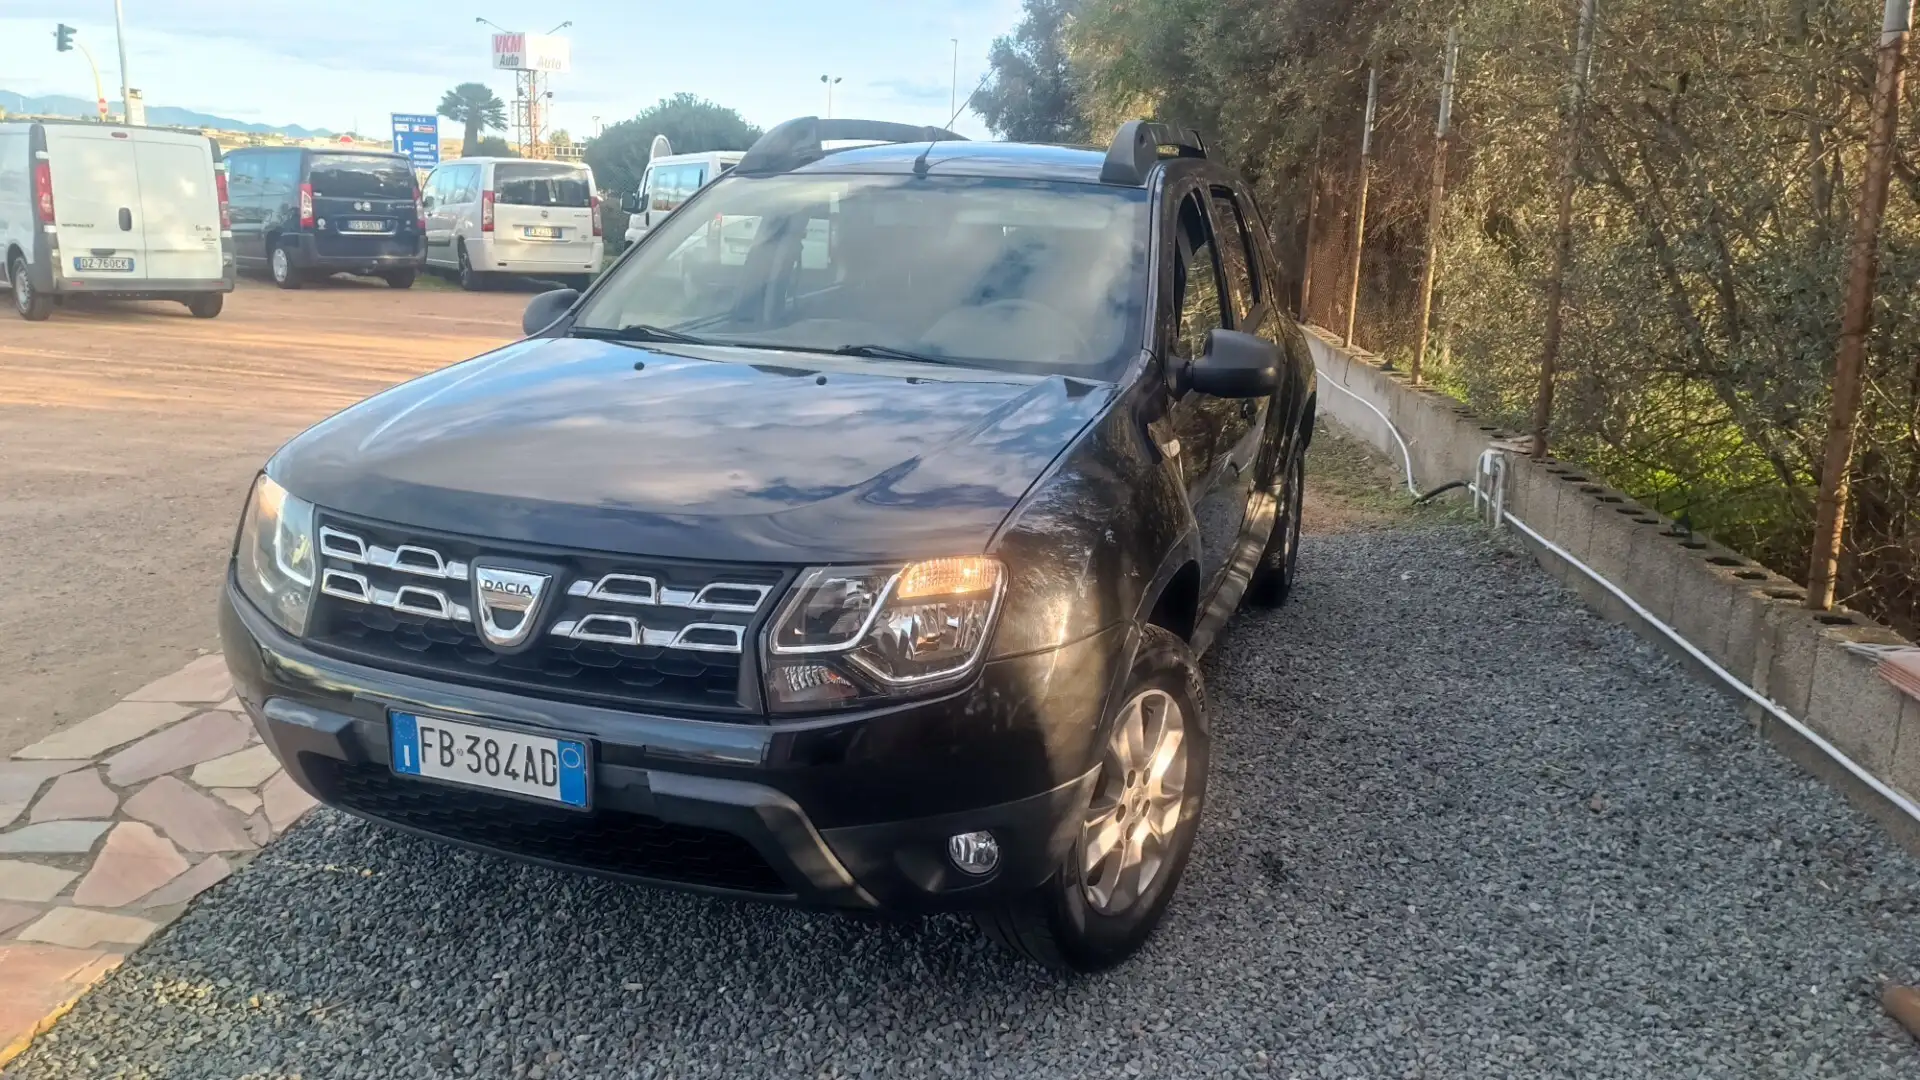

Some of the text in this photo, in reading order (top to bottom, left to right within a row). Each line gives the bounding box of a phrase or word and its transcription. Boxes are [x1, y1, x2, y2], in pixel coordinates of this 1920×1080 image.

[495, 35, 522, 53] VKM
[499, 53, 520, 66] Auto
[536, 55, 561, 70] Auto
[484, 579, 532, 595] DACIA
[419, 726, 455, 768] FB
[465, 734, 558, 787] 384AD
